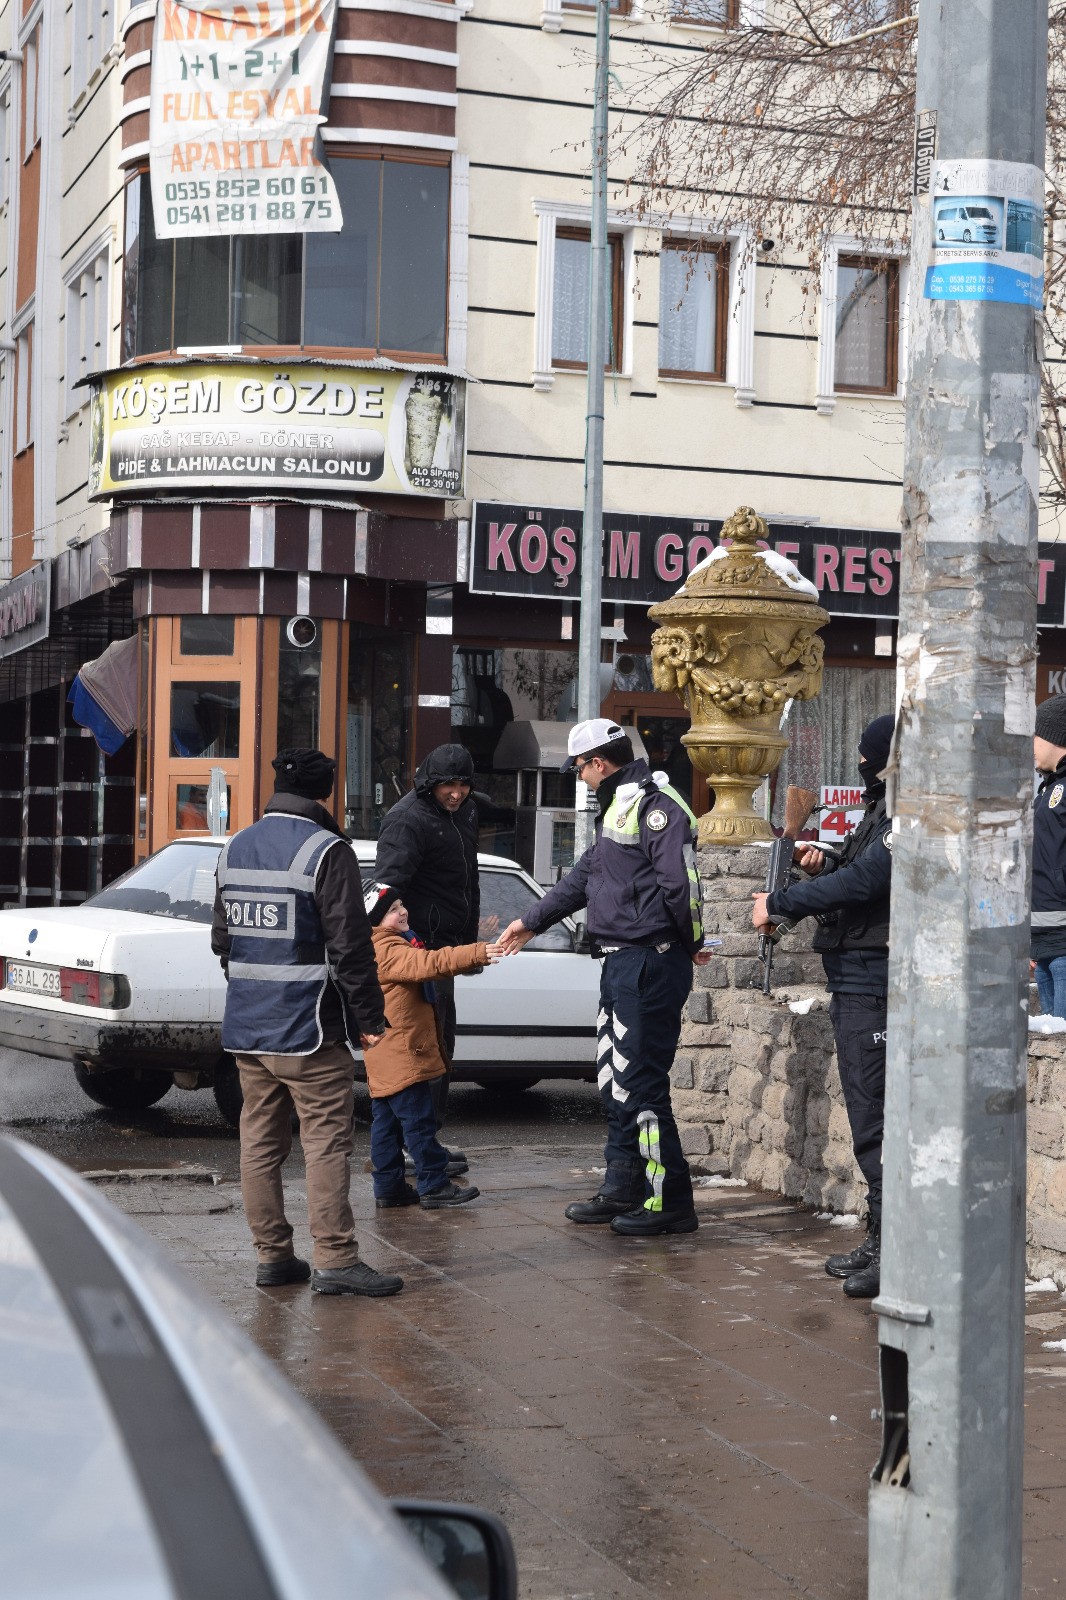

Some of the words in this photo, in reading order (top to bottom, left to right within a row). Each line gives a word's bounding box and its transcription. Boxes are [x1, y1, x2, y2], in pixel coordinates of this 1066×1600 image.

[163, 91, 219, 122] FULL
[165, 180, 211, 201] 0535
[216, 178, 260, 198] 852
[266, 177, 295, 197] 60
[301, 176, 328, 195] 61
[167, 204, 210, 225] 0541
[217, 203, 257, 222] 281
[267, 201, 295, 220] 88
[302, 200, 332, 219] 75
[112, 377, 221, 424] KÖŞEM
[234, 372, 384, 418] GÖZDE
[177, 431, 240, 447] KEBAP
[259, 430, 334, 449] DÖNER
[118, 458, 145, 476] PİDE
[150, 458, 161, 472] &
[167, 456, 275, 472] LAHMACUN
[283, 457, 371, 476] SALONU
[412, 467, 429, 476] ALO
[414, 477, 430, 487] 212
[432, 479, 443, 488] 39
[445, 480, 455, 489] 01
[488, 510, 641, 588] KÖŞM
[814, 543, 900, 596] RES
[824, 788, 864, 806] LAHM
[26, 969, 39, 987] AL
[42, 972, 60, 991] 293
